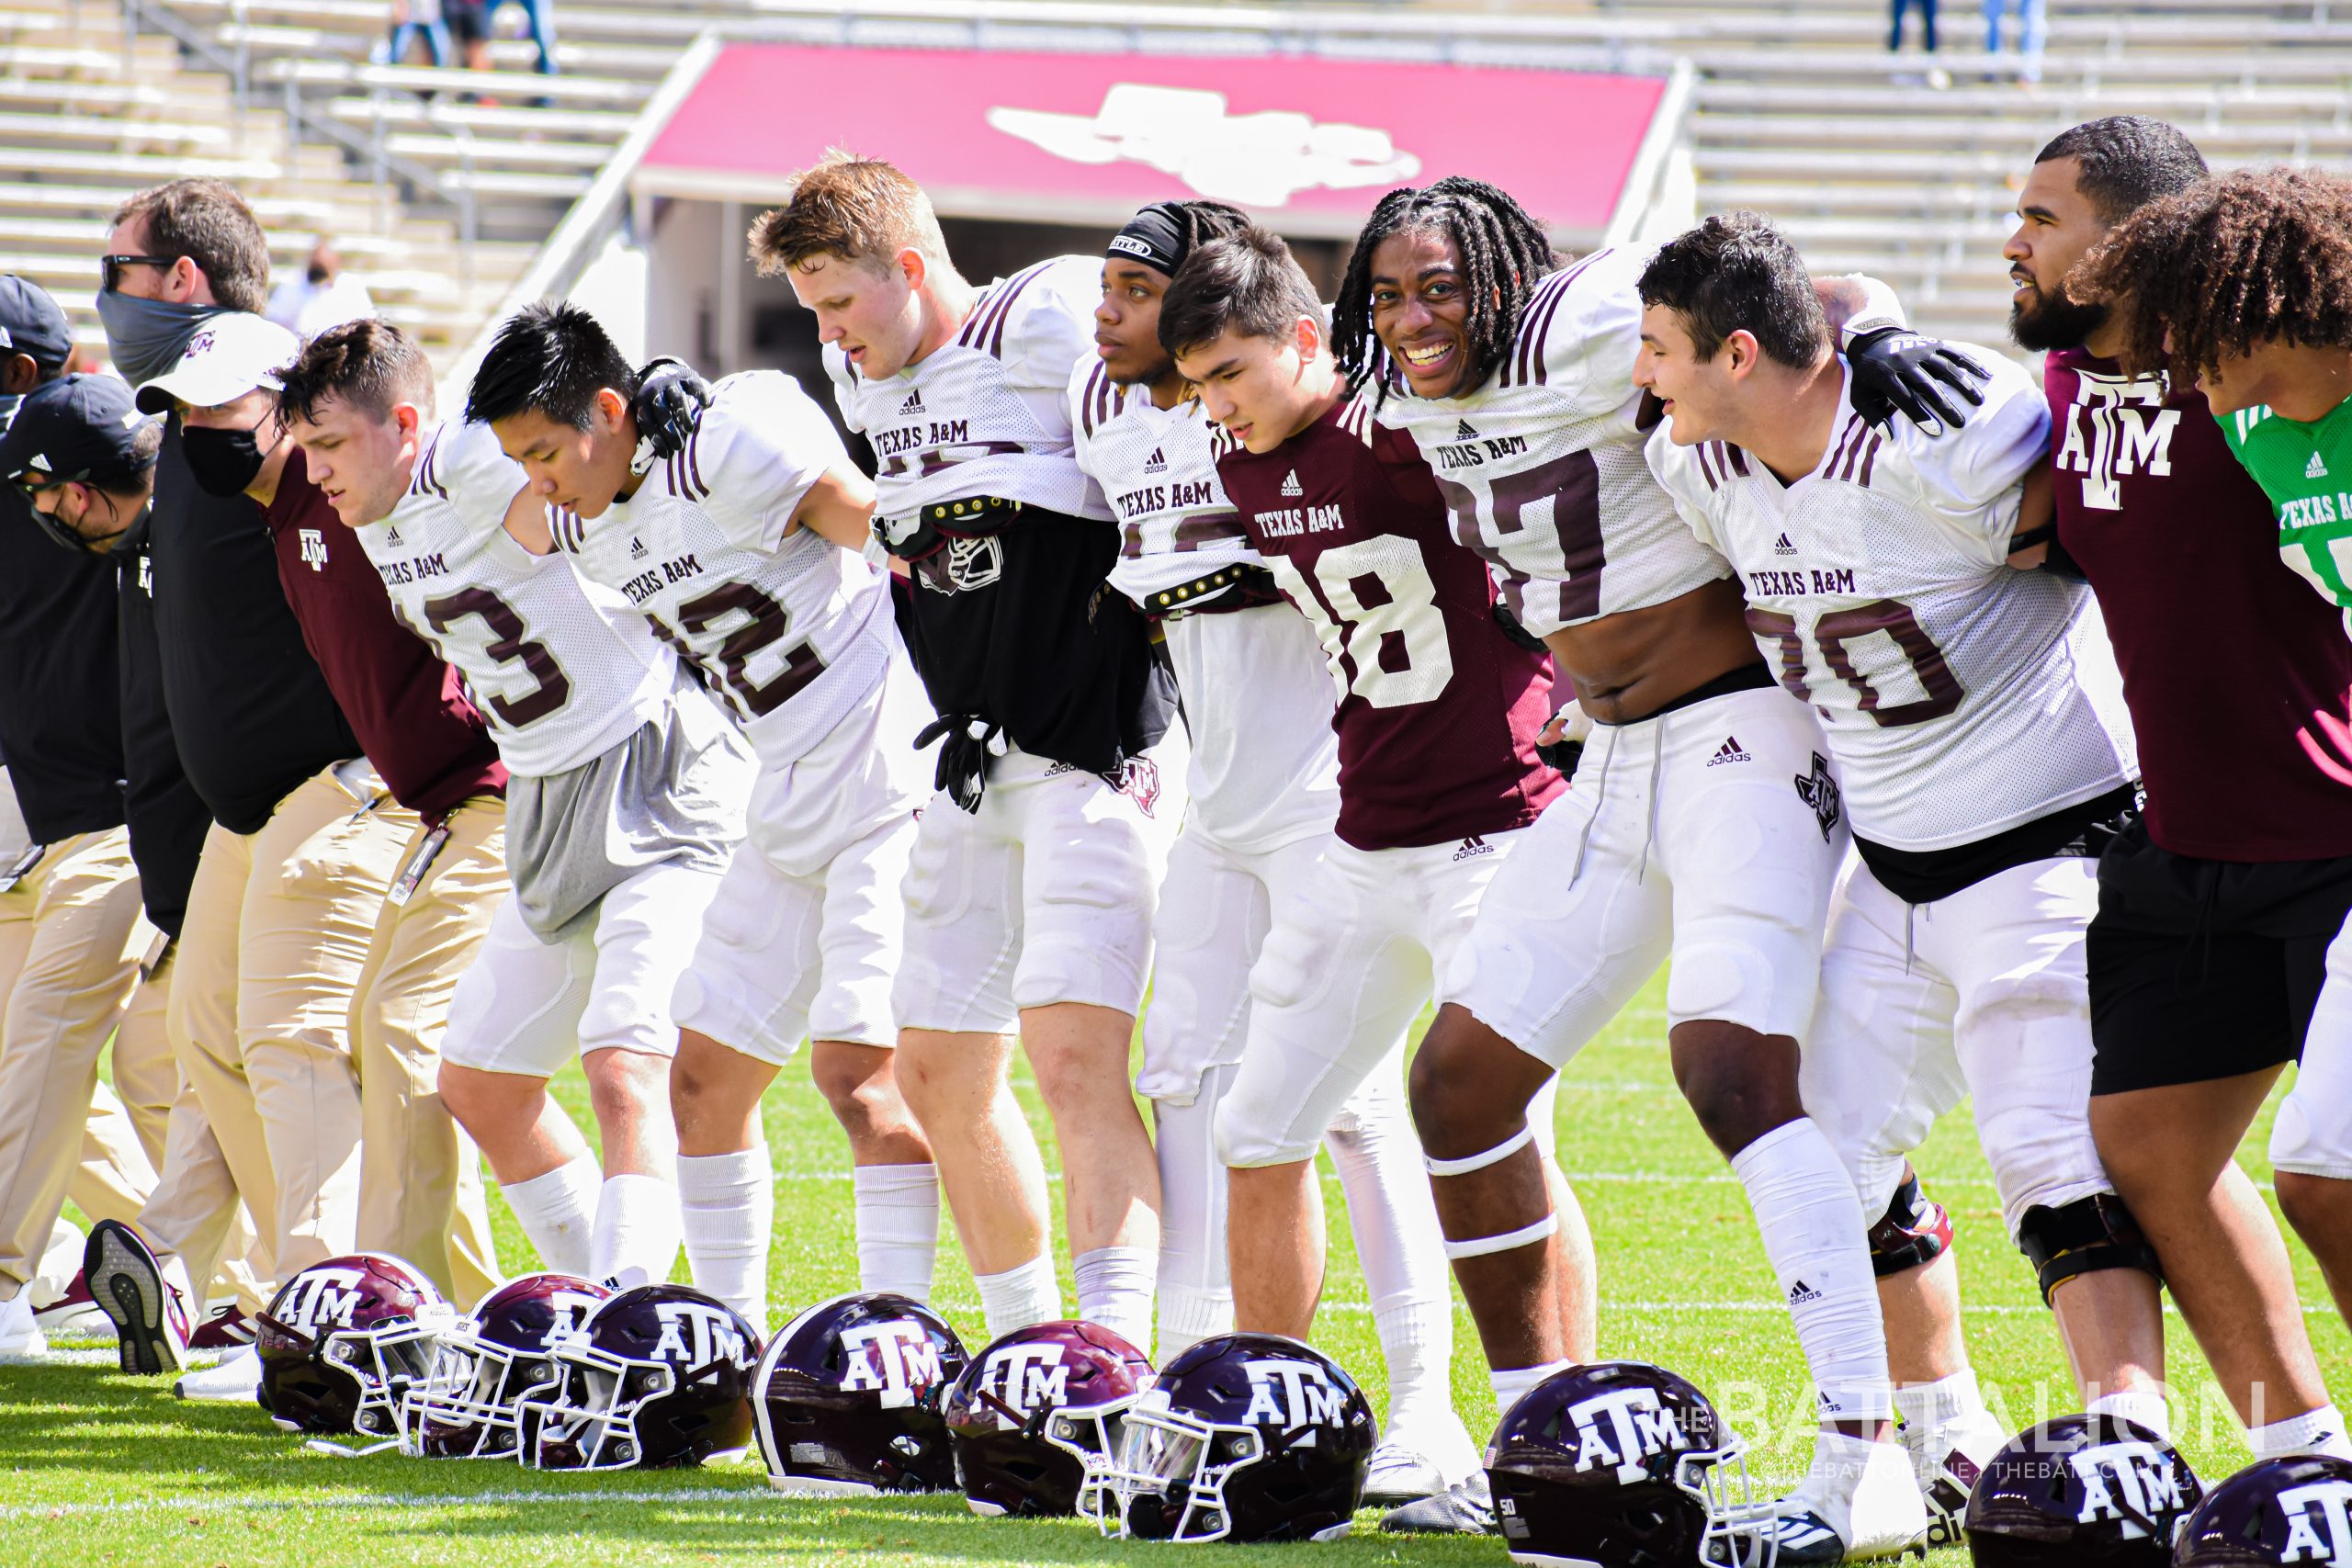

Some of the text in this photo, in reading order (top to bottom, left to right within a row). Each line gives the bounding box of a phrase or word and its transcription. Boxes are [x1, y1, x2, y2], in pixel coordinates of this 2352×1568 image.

[899, 404, 925, 416] adidas
[875, 420, 968, 457] TEXAS A&M
[1437, 435, 1528, 469] TEXAS A&M
[1144, 462, 1168, 474] adidas
[1116, 481, 1214, 519] TEXAS A&M
[1281, 486, 1303, 496] adidas
[1254, 508, 1305, 538] TEXAS
[1306, 504, 1345, 531] A&M
[2279, 495, 2337, 530] TEXAS
[413, 553, 449, 579] A&M
[621, 553, 704, 606] TEXAS A&M
[1749, 569, 1856, 596] TEXAS A&M
[1044, 762, 1079, 777] adida
[1706, 752, 1752, 767] adidas
[1453, 845, 1495, 862] adidas
[1499, 1498, 1516, 1516] 50
